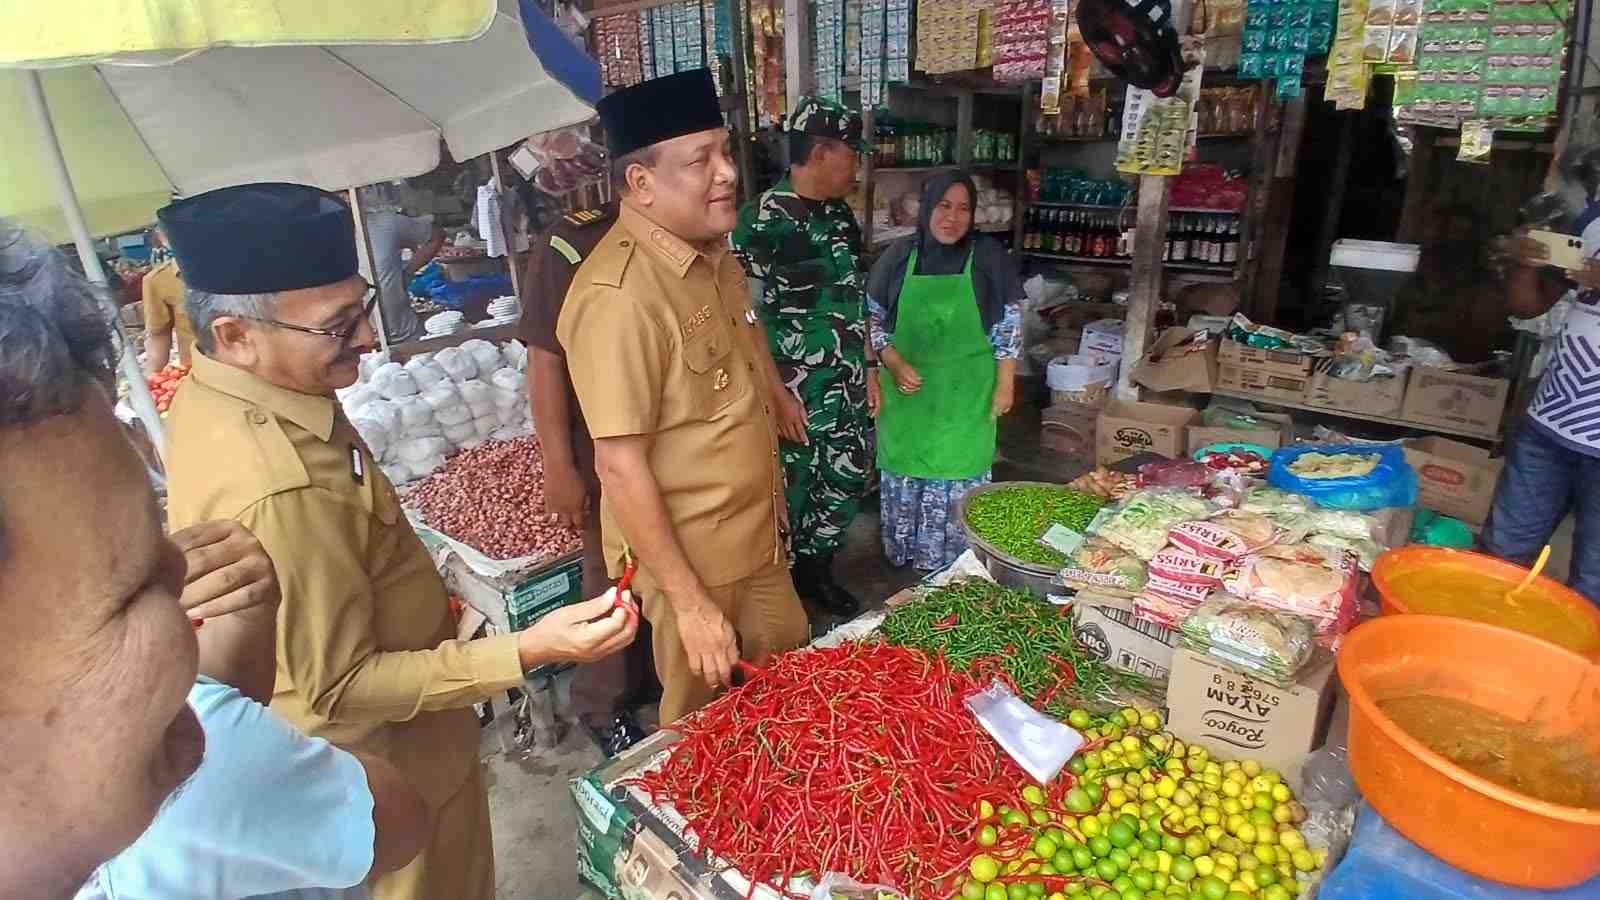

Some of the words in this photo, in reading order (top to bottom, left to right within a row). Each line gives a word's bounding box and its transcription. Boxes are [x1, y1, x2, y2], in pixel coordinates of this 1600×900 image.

[1157, 554, 1201, 569] ARISS
[1078, 632, 1106, 652] ABC
[1227, 680, 1235, 691] 8
[1207, 687, 1270, 717] AYAM
[1253, 690, 1279, 706] 576
[1206, 719, 1264, 743] Royco
